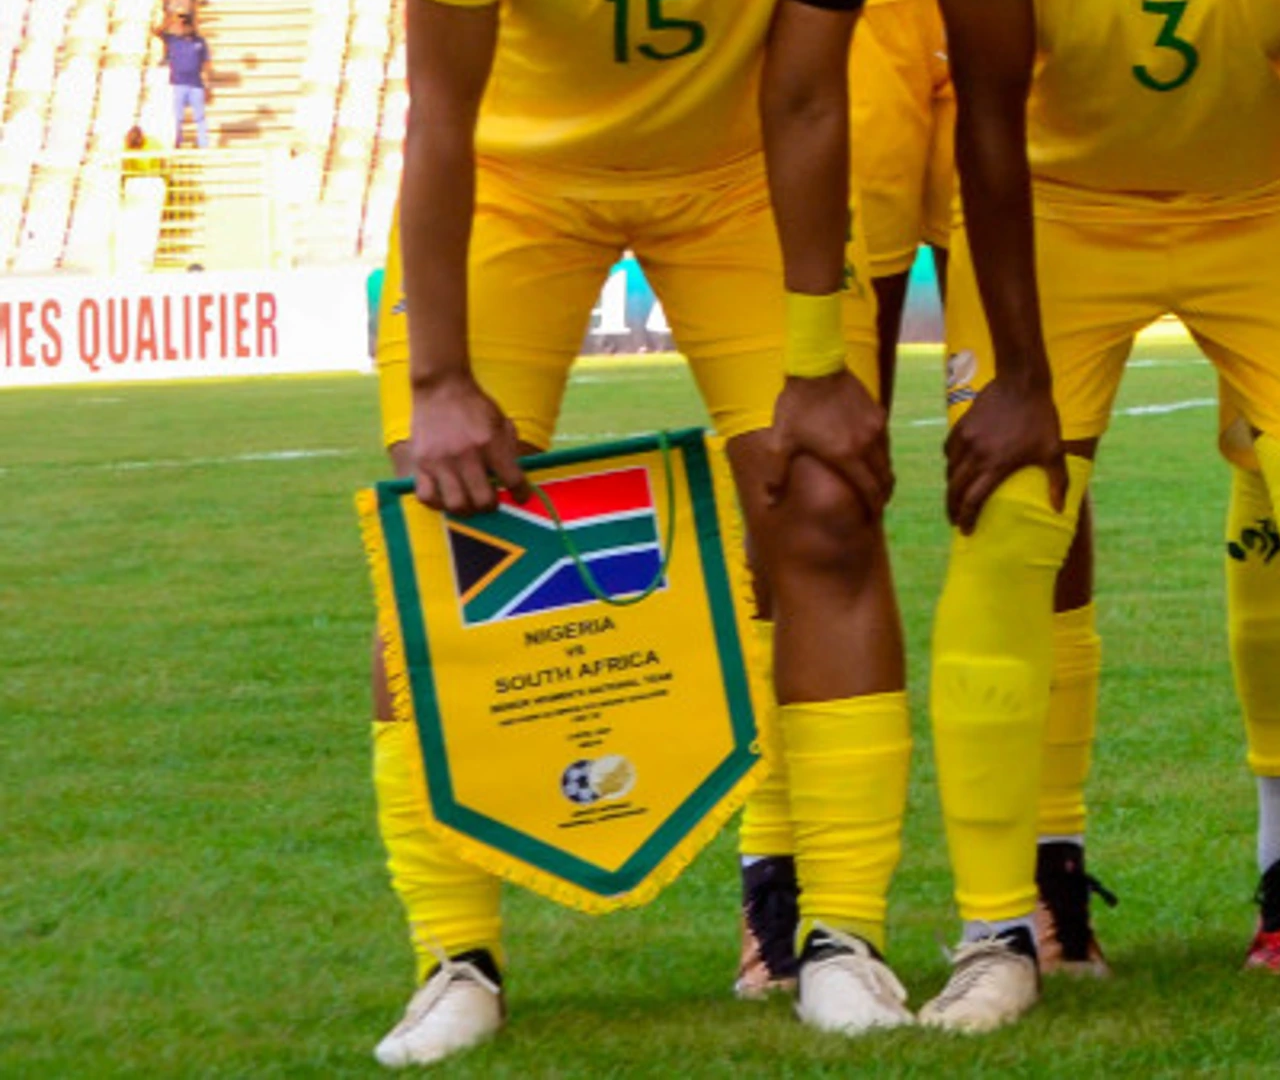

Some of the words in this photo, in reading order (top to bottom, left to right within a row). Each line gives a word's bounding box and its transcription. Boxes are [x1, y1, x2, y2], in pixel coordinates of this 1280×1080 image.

[1131, 0, 1198, 91] 3
[78, 292, 278, 372] QUALIFIER
[524, 616, 616, 646] NIGERIA
[494, 667, 573, 694] SOUTH
[578, 650, 661, 678] AFRICA
